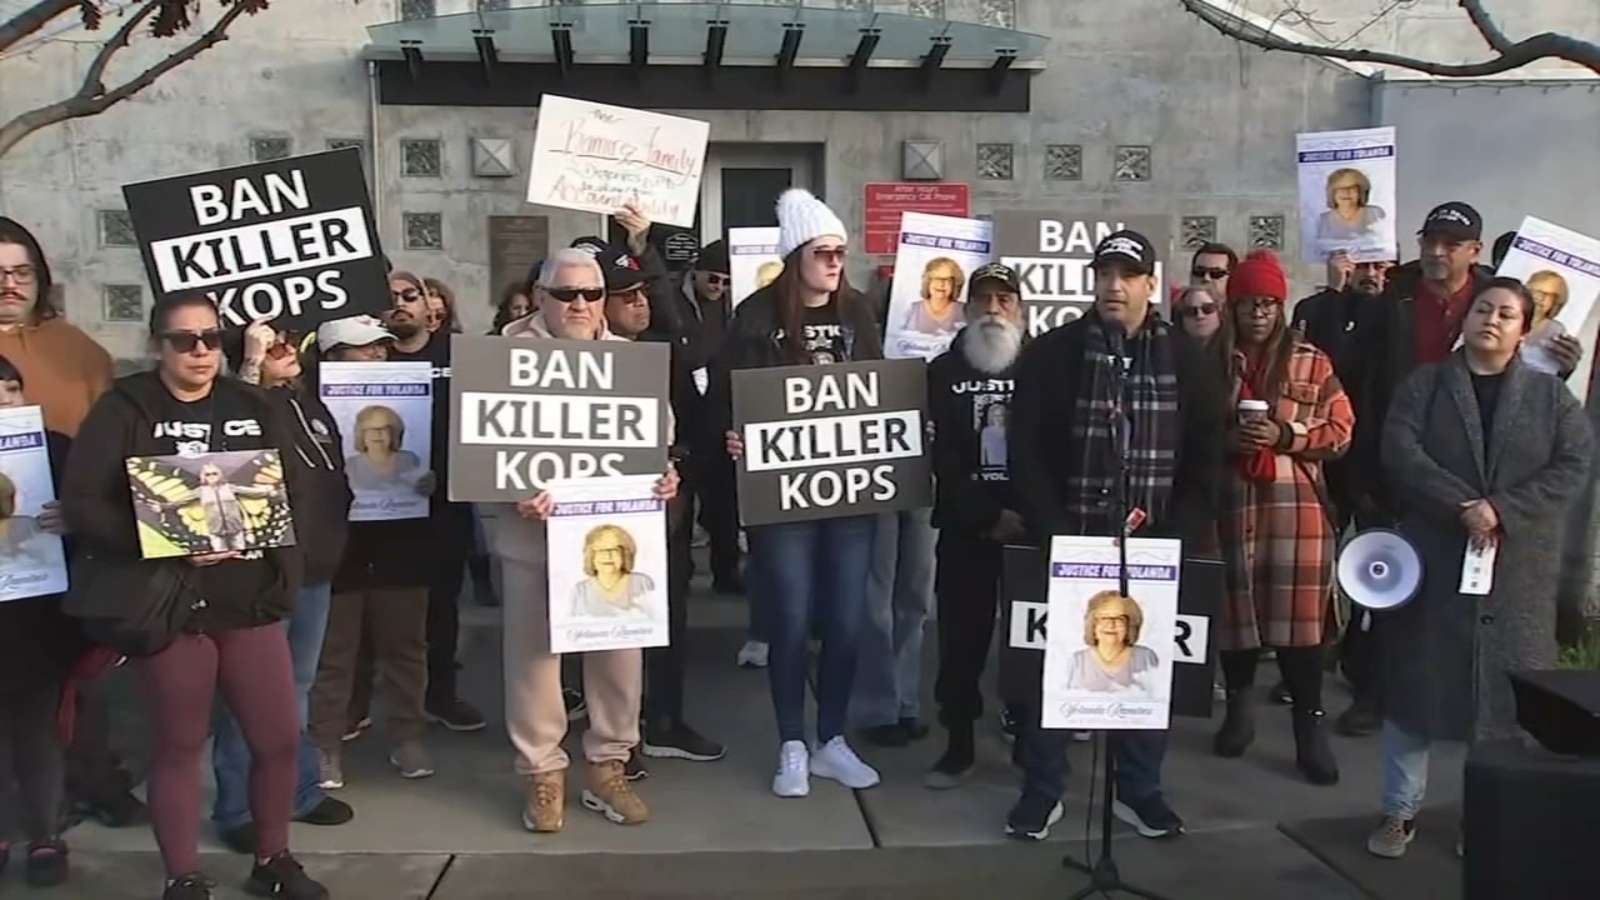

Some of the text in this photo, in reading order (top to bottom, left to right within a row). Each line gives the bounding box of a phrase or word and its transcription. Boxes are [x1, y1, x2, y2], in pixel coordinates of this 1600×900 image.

[1336, 149, 1352, 160] FOR
[190, 170, 309, 226] BAN
[172, 219, 357, 283] KILLER
[205, 271, 347, 327] KOPS
[510, 348, 613, 389] BAN
[365, 384, 383, 396] FOR
[785, 372, 879, 413] BAN
[478, 399, 645, 441] KILLER
[760, 418, 911, 464] KILLER
[496, 450, 625, 489] KOPS
[780, 465, 896, 510] KOPS
[1057, 564, 1101, 578] JUSTICE
